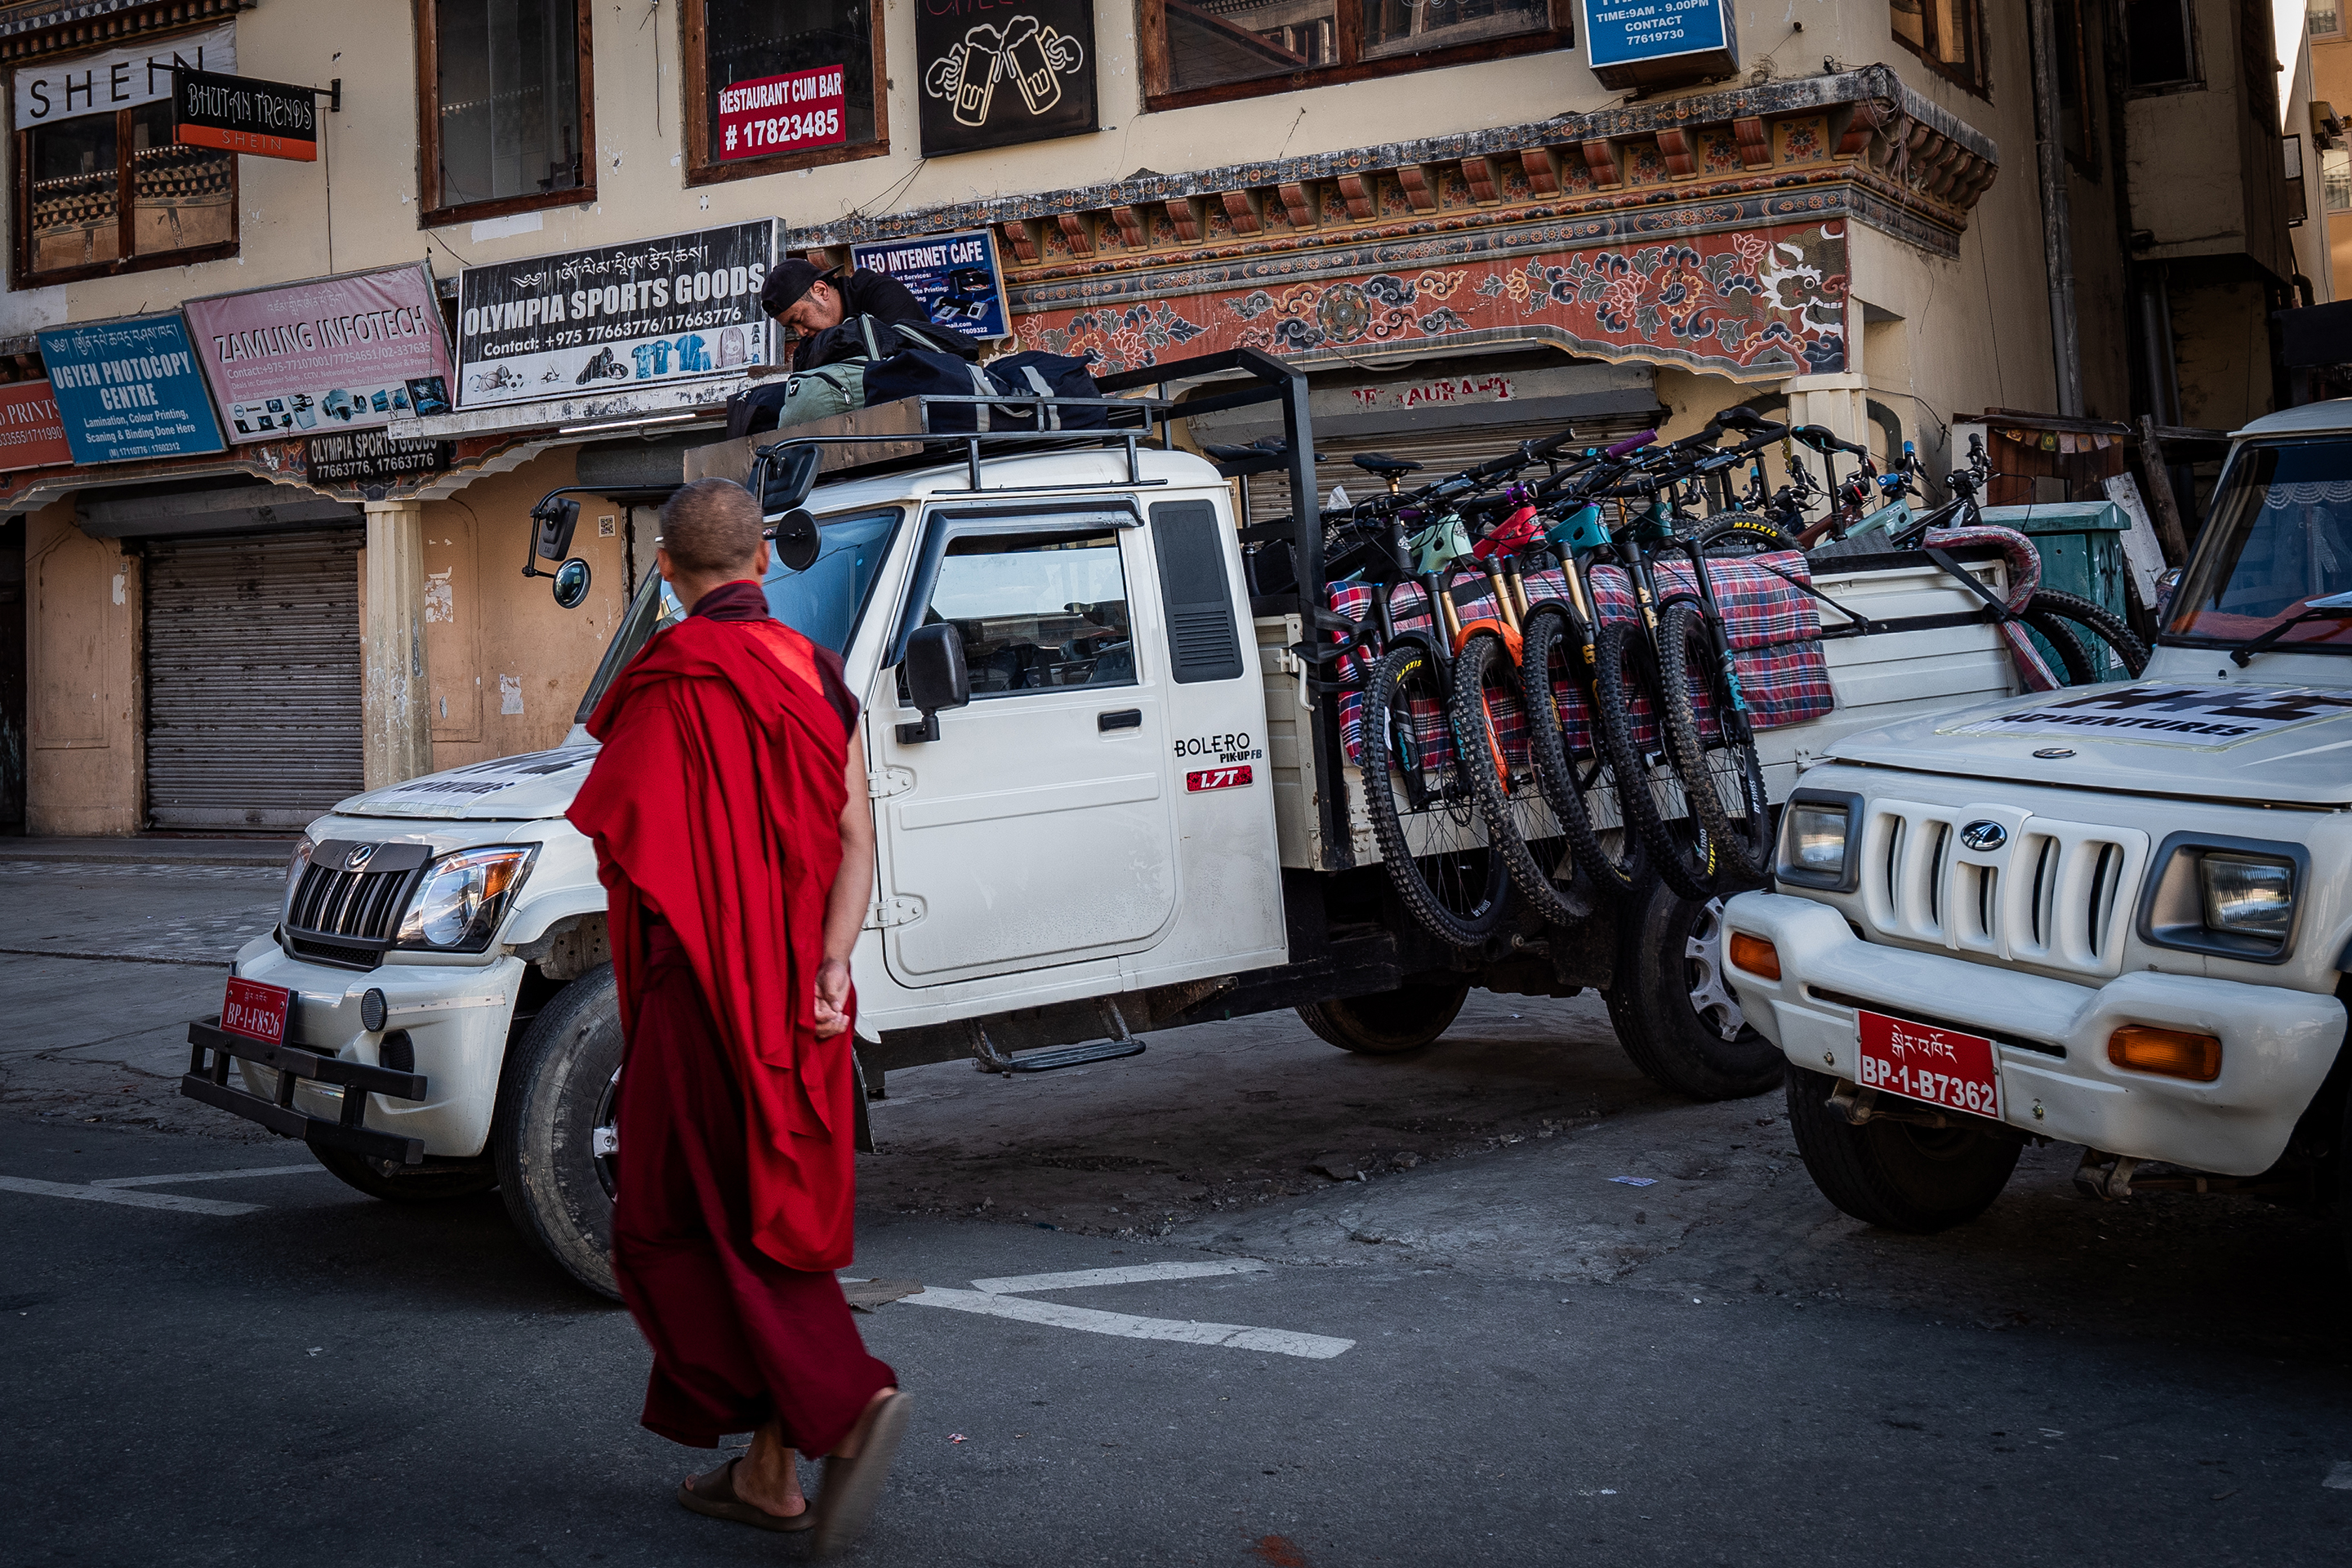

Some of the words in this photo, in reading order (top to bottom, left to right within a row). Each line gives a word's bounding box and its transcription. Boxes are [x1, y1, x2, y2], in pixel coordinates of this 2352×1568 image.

[1596, 6, 1655, 23] TIME:9AM
[1665, 0, 1709, 13] 9.00PM
[1625, 15, 1682, 32] CONTACT
[1627, 29, 1685, 46] 77619730
[719, 81, 790, 114] RESTAURANT
[791, 76, 817, 103] CUM
[819, 72, 842, 98] BAR
[188, 82, 252, 122] BHUTAN
[254, 91, 313, 131] TRENDS
[222, 130, 283, 150] SHEIN
[725, 124, 737, 151] #
[743, 108, 839, 148] 17823485
[888, 245, 947, 271] INTERNET
[951, 240, 984, 264] CAFE
[464, 293, 566, 337] OLYMPIA
[571, 277, 669, 321] SPORTS
[675, 262, 767, 305] GOODS
[213, 323, 316, 364] ZAMLING
[316, 305, 430, 349] INFOTECH
[483, 338, 539, 358] Contact:
[545, 330, 583, 349] +975
[586, 306, 742, 341] 77663776/17663776
[52, 363, 101, 390] UGYEN
[100, 350, 192, 385] PHOTOCOPY
[256, 376, 284, 387] Computer
[100, 382, 159, 411] CENTRE
[84, 415, 129, 429] Lamination,
[128, 412, 154, 424] Colour
[154, 408, 189, 420] Printing,
[387, 409, 399, 420] TV
[85, 431, 117, 443] Scaning
[118, 430, 124, 441] &
[124, 427, 155, 439] Binding
[154, 425, 176, 436] Done
[176, 422, 196, 434] Here
[109, 448, 119, 459] (M)
[119, 445, 148, 456] 17110776
[311, 434, 354, 463] OLYMPIA
[317, 461, 374, 479] 77663776,
[376, 452, 434, 472] 17663776
[1733, 521, 1778, 537] MAXXIS
[1991, 712, 2262, 736] ADVENTURES
[1174, 733, 1250, 758] BOLERO
[1220, 751, 1250, 764] PIK-UP
[1250, 749, 1263, 760] FB
[1200, 769, 1238, 789] 1.7T
[226, 1002, 281, 1036] BP-1-F8526
[1861, 1054, 1997, 1116] BP-1-B7362
